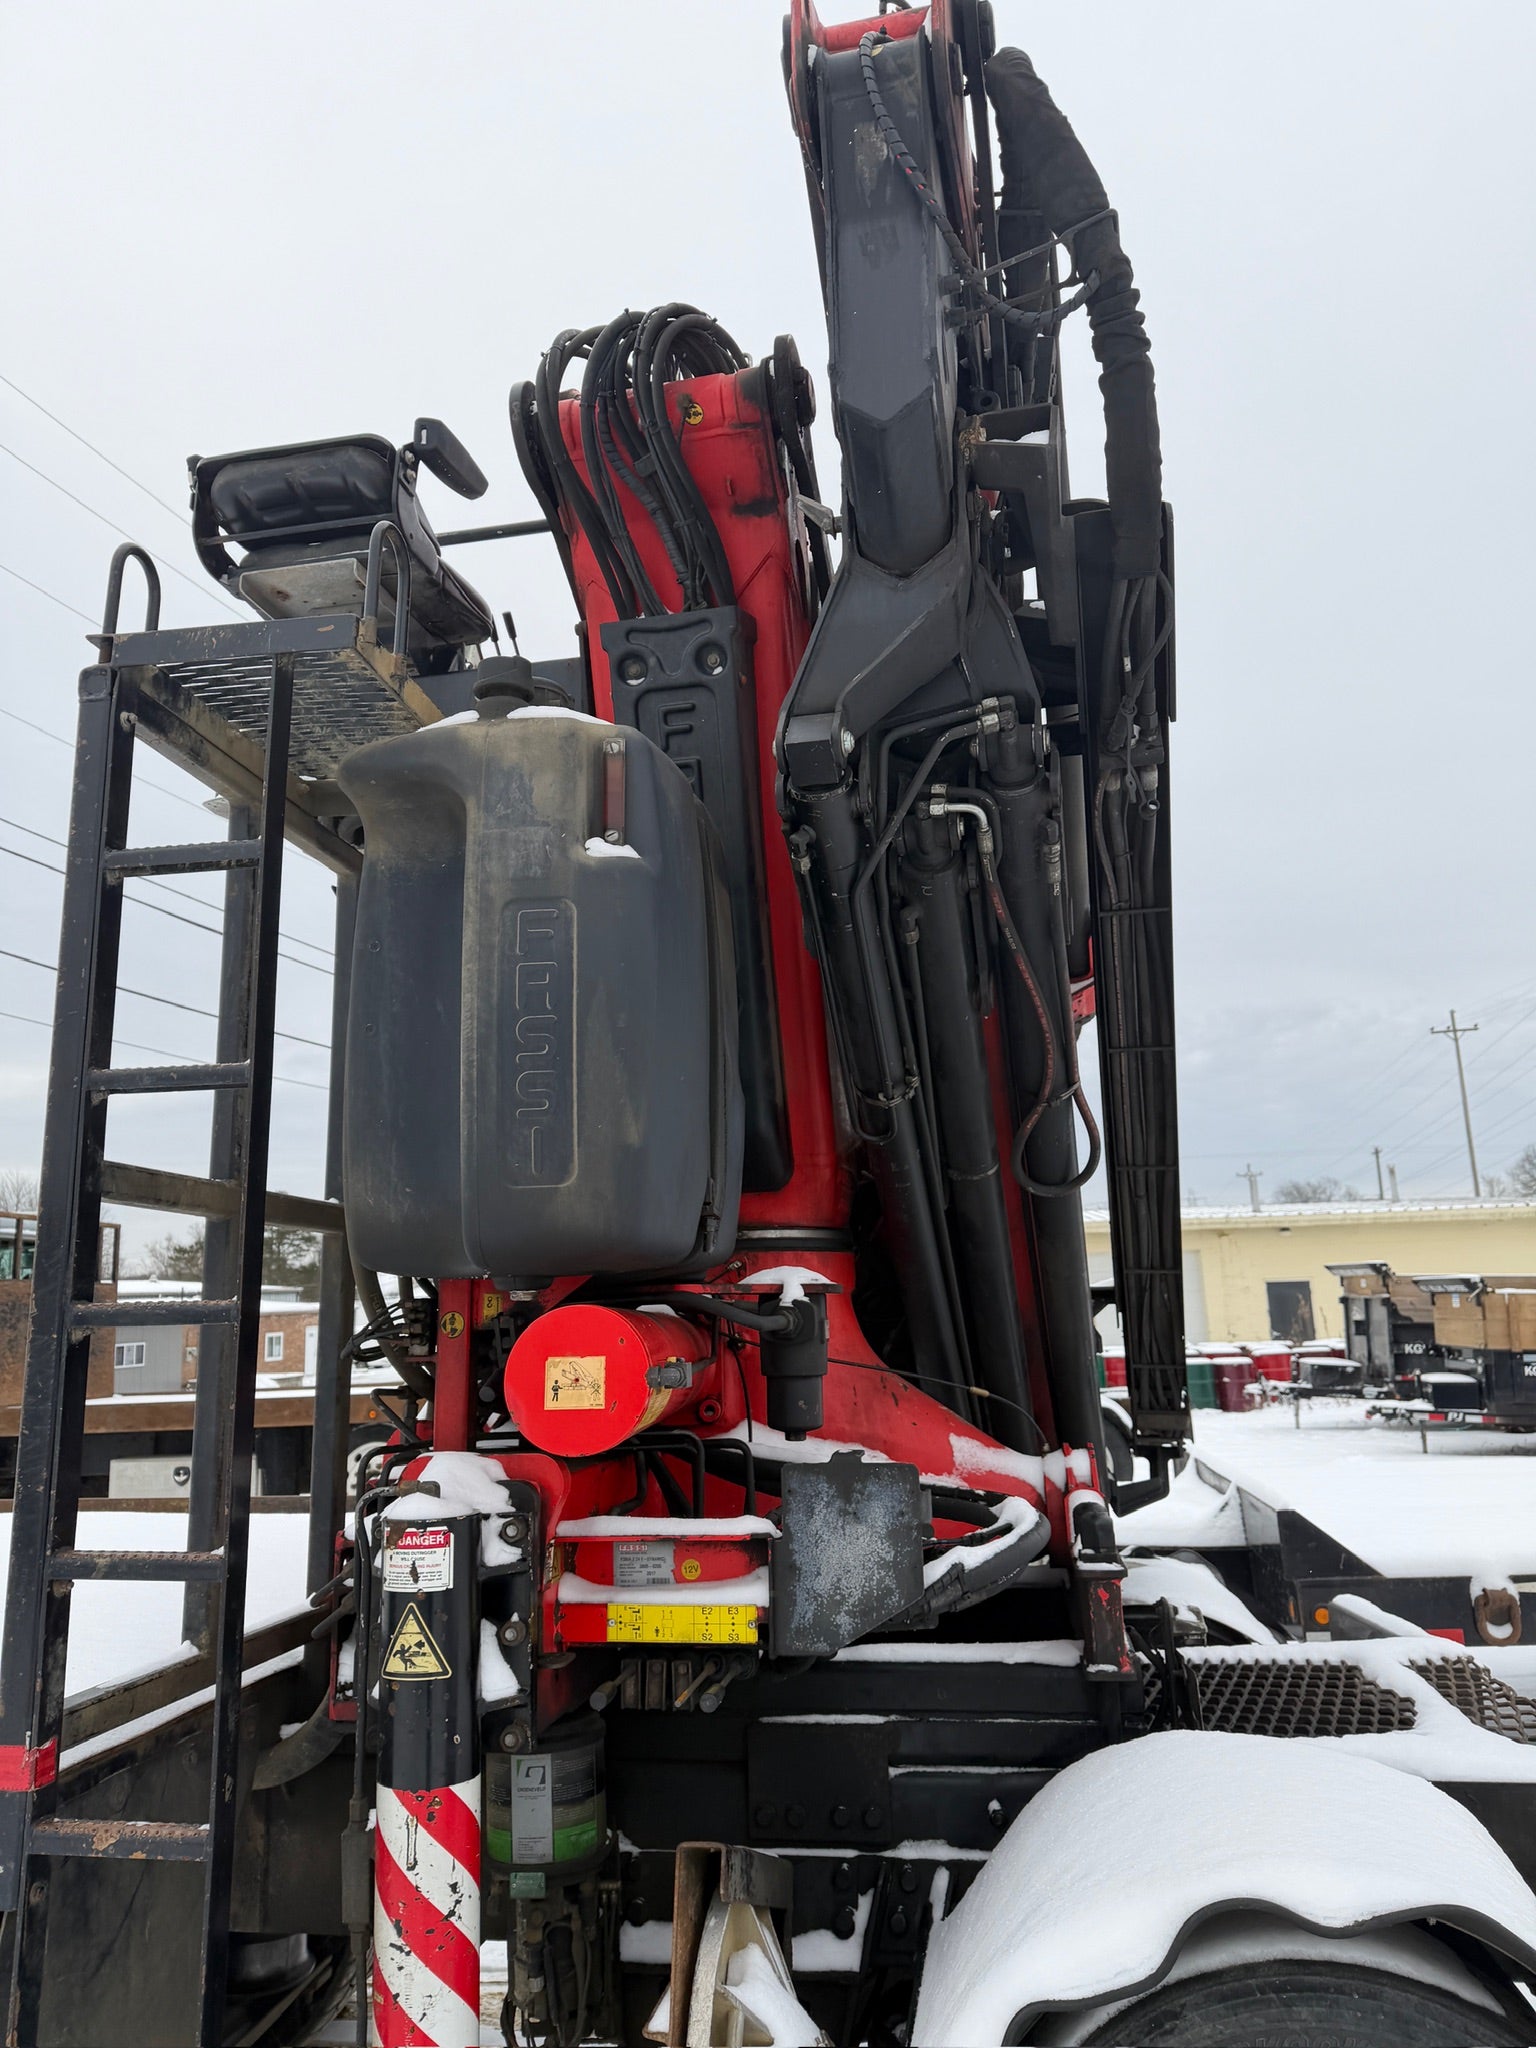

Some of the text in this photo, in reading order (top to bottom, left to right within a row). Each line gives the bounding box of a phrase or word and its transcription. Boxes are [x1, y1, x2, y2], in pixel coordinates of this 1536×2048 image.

[514, 907, 561, 1178] FASSI
[683, 1564, 699, 1574] 12V
[701, 1606, 713, 1615] E2
[727, 1606, 739, 1615] E3
[701, 1633, 713, 1642] S2
[728, 1633, 740, 1642] S3
